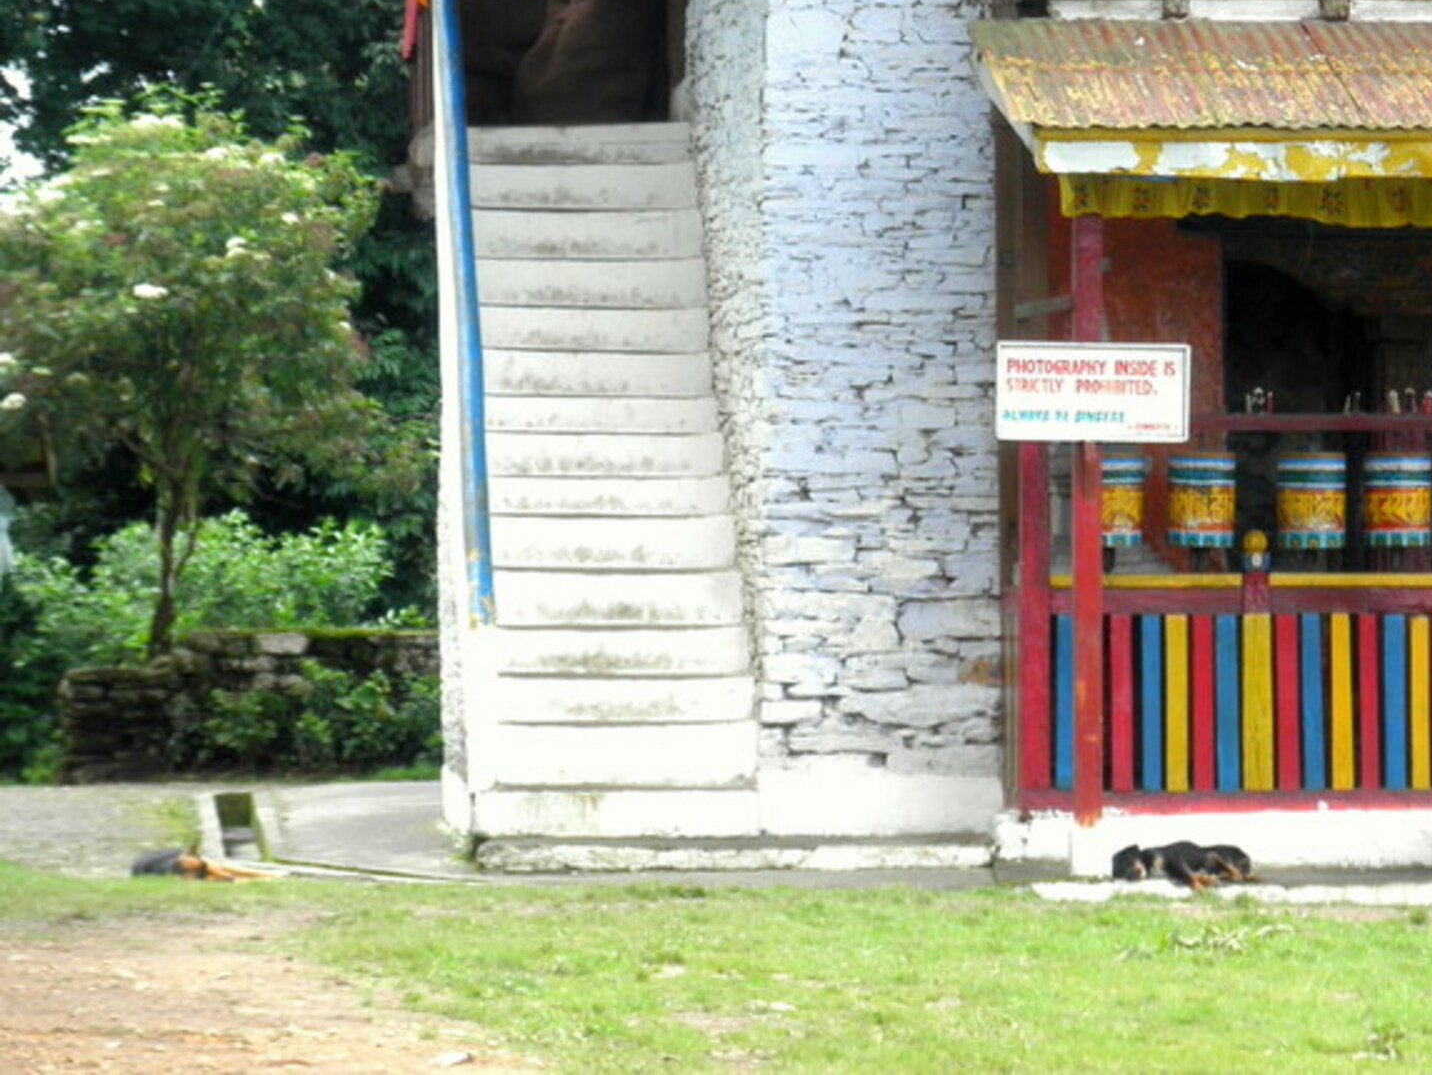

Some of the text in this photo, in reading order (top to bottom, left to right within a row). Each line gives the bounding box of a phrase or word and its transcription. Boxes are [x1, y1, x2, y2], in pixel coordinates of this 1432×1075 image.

[1007, 358, 1176, 376] PHOTOGRAPHY INSIDE IS
[1006, 378, 1063, 393] STRICTLY
